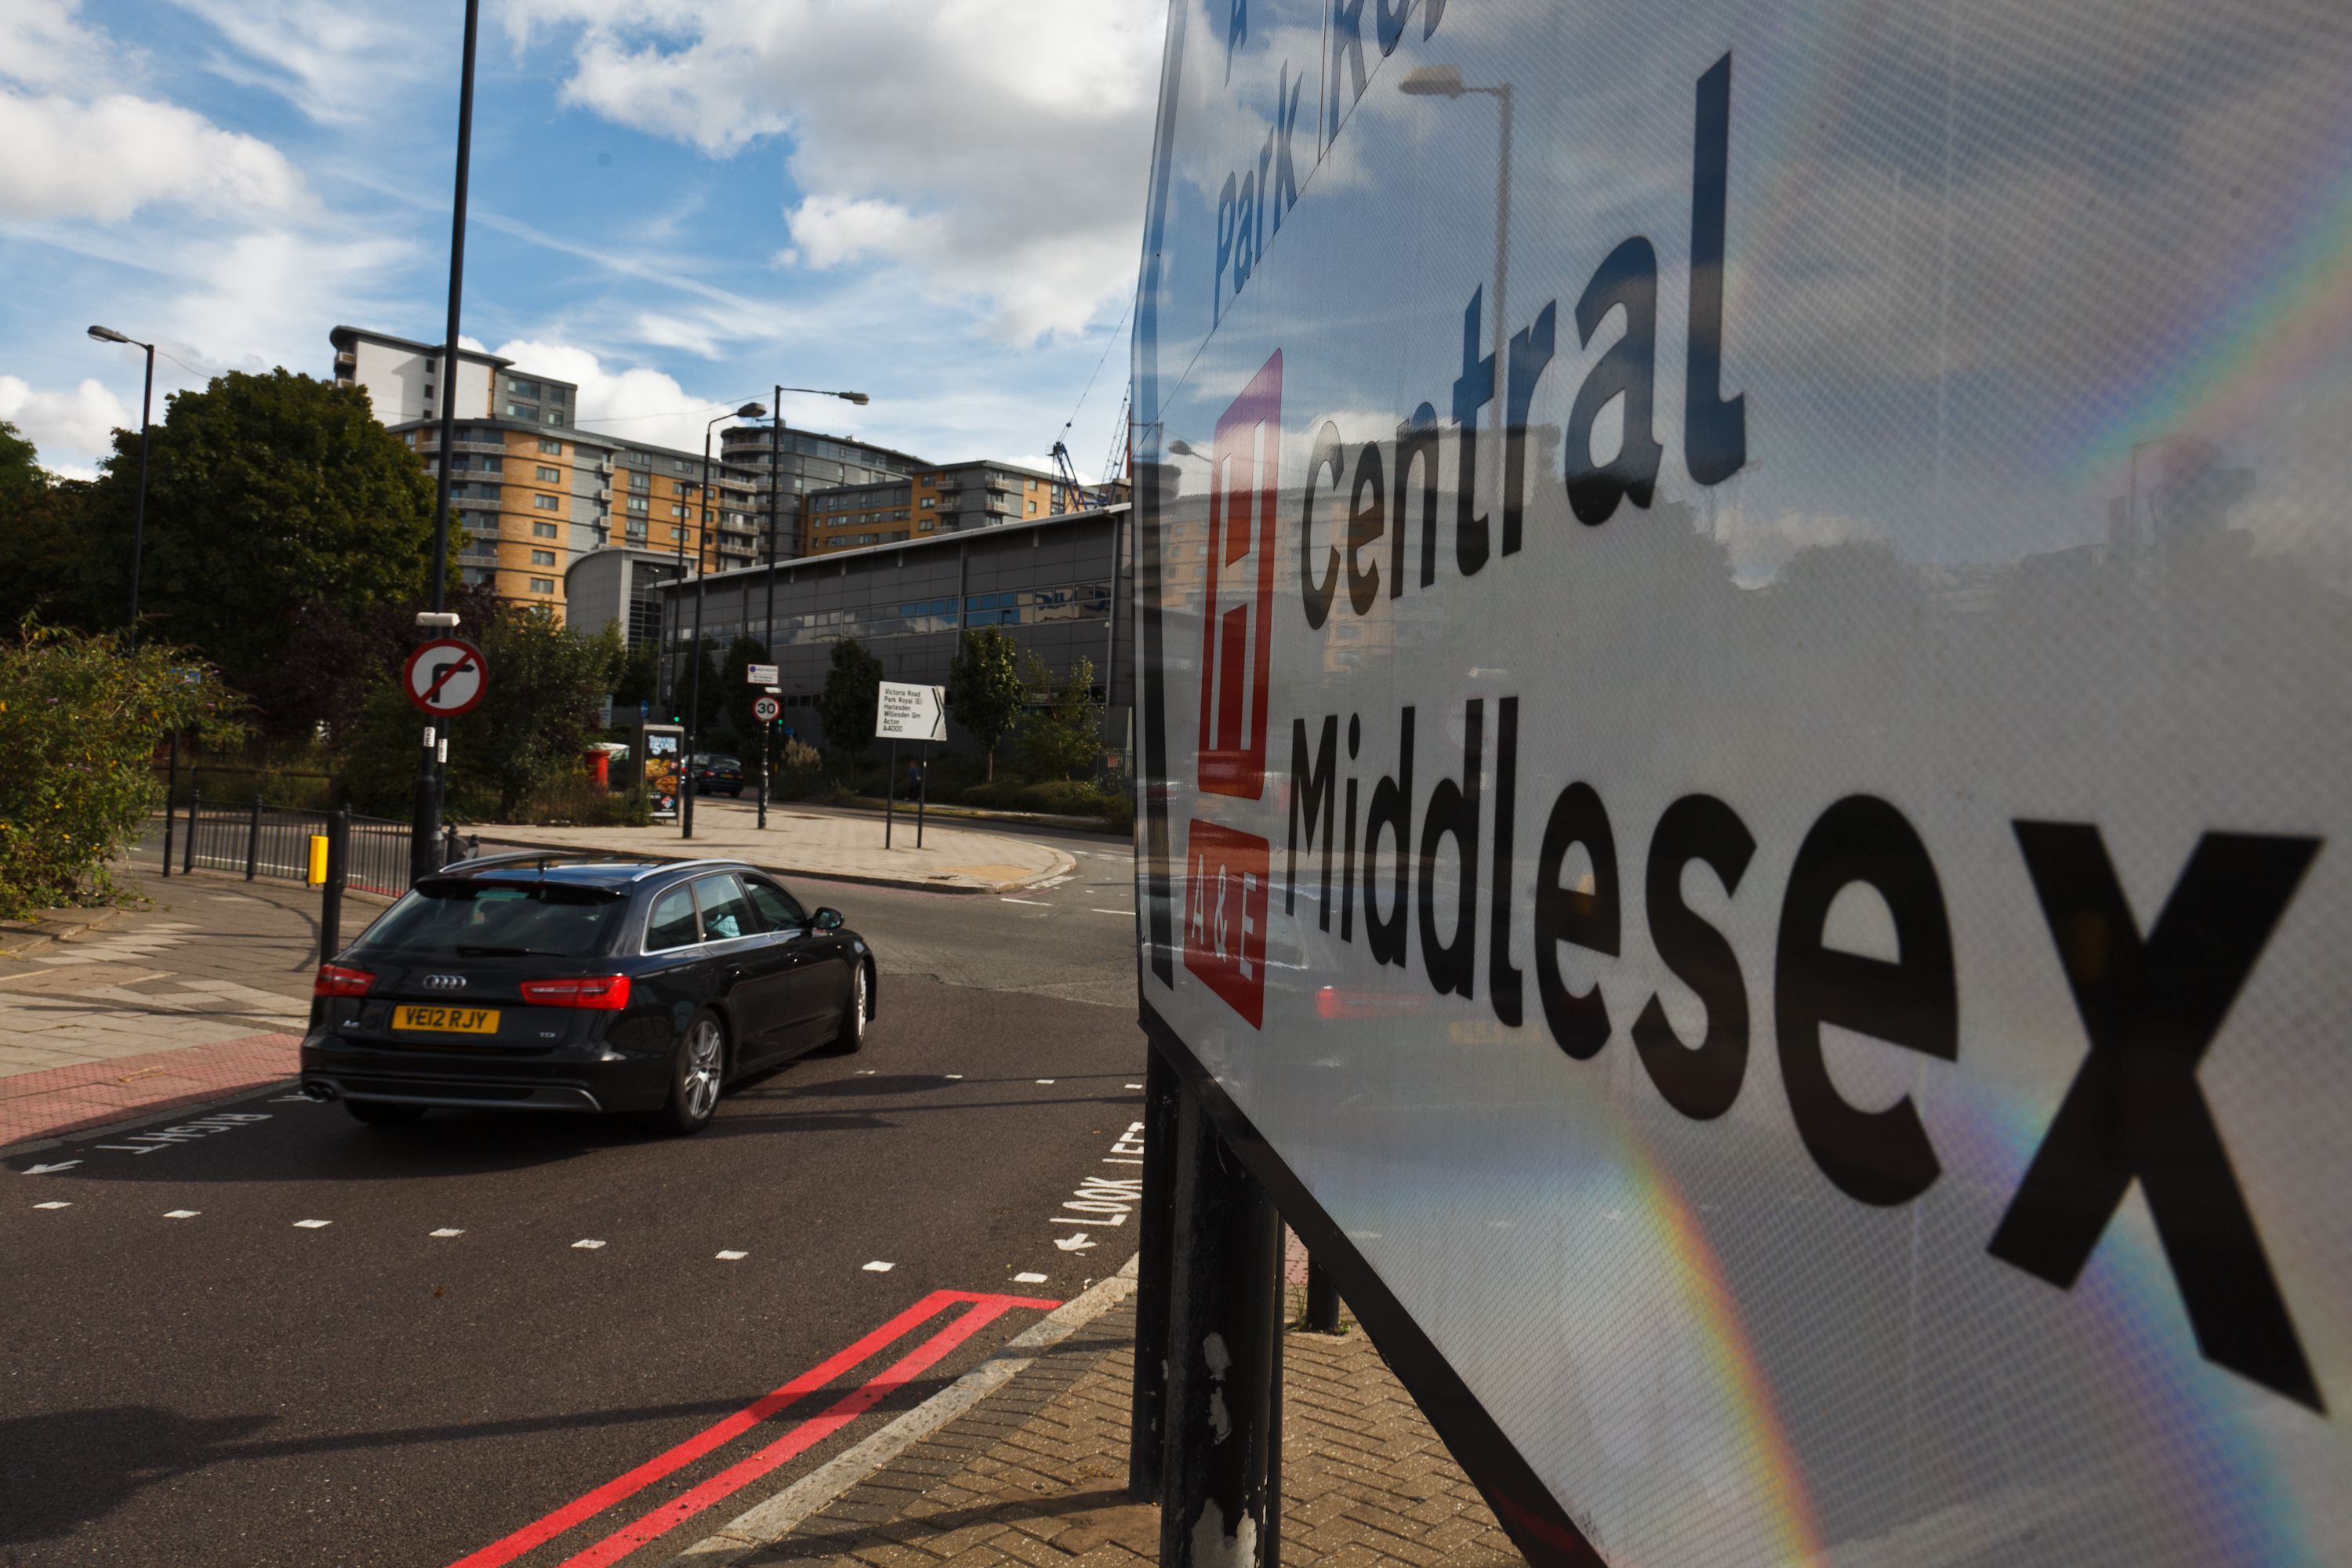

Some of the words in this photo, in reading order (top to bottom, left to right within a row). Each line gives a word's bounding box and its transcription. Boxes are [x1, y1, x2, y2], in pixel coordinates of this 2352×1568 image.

[1213, 57, 1303, 330] Park
[1301, 50, 1746, 630] Central
[757, 702, 776, 714] 30
[405, 1007, 446, 1027] VE12
[448, 1011, 488, 1029] RJY
[1285, 695, 2328, 1417] Middlesex
[94, 1112, 274, 1155] RIGHT
[1049, 1176, 1143, 1227] LOOK
